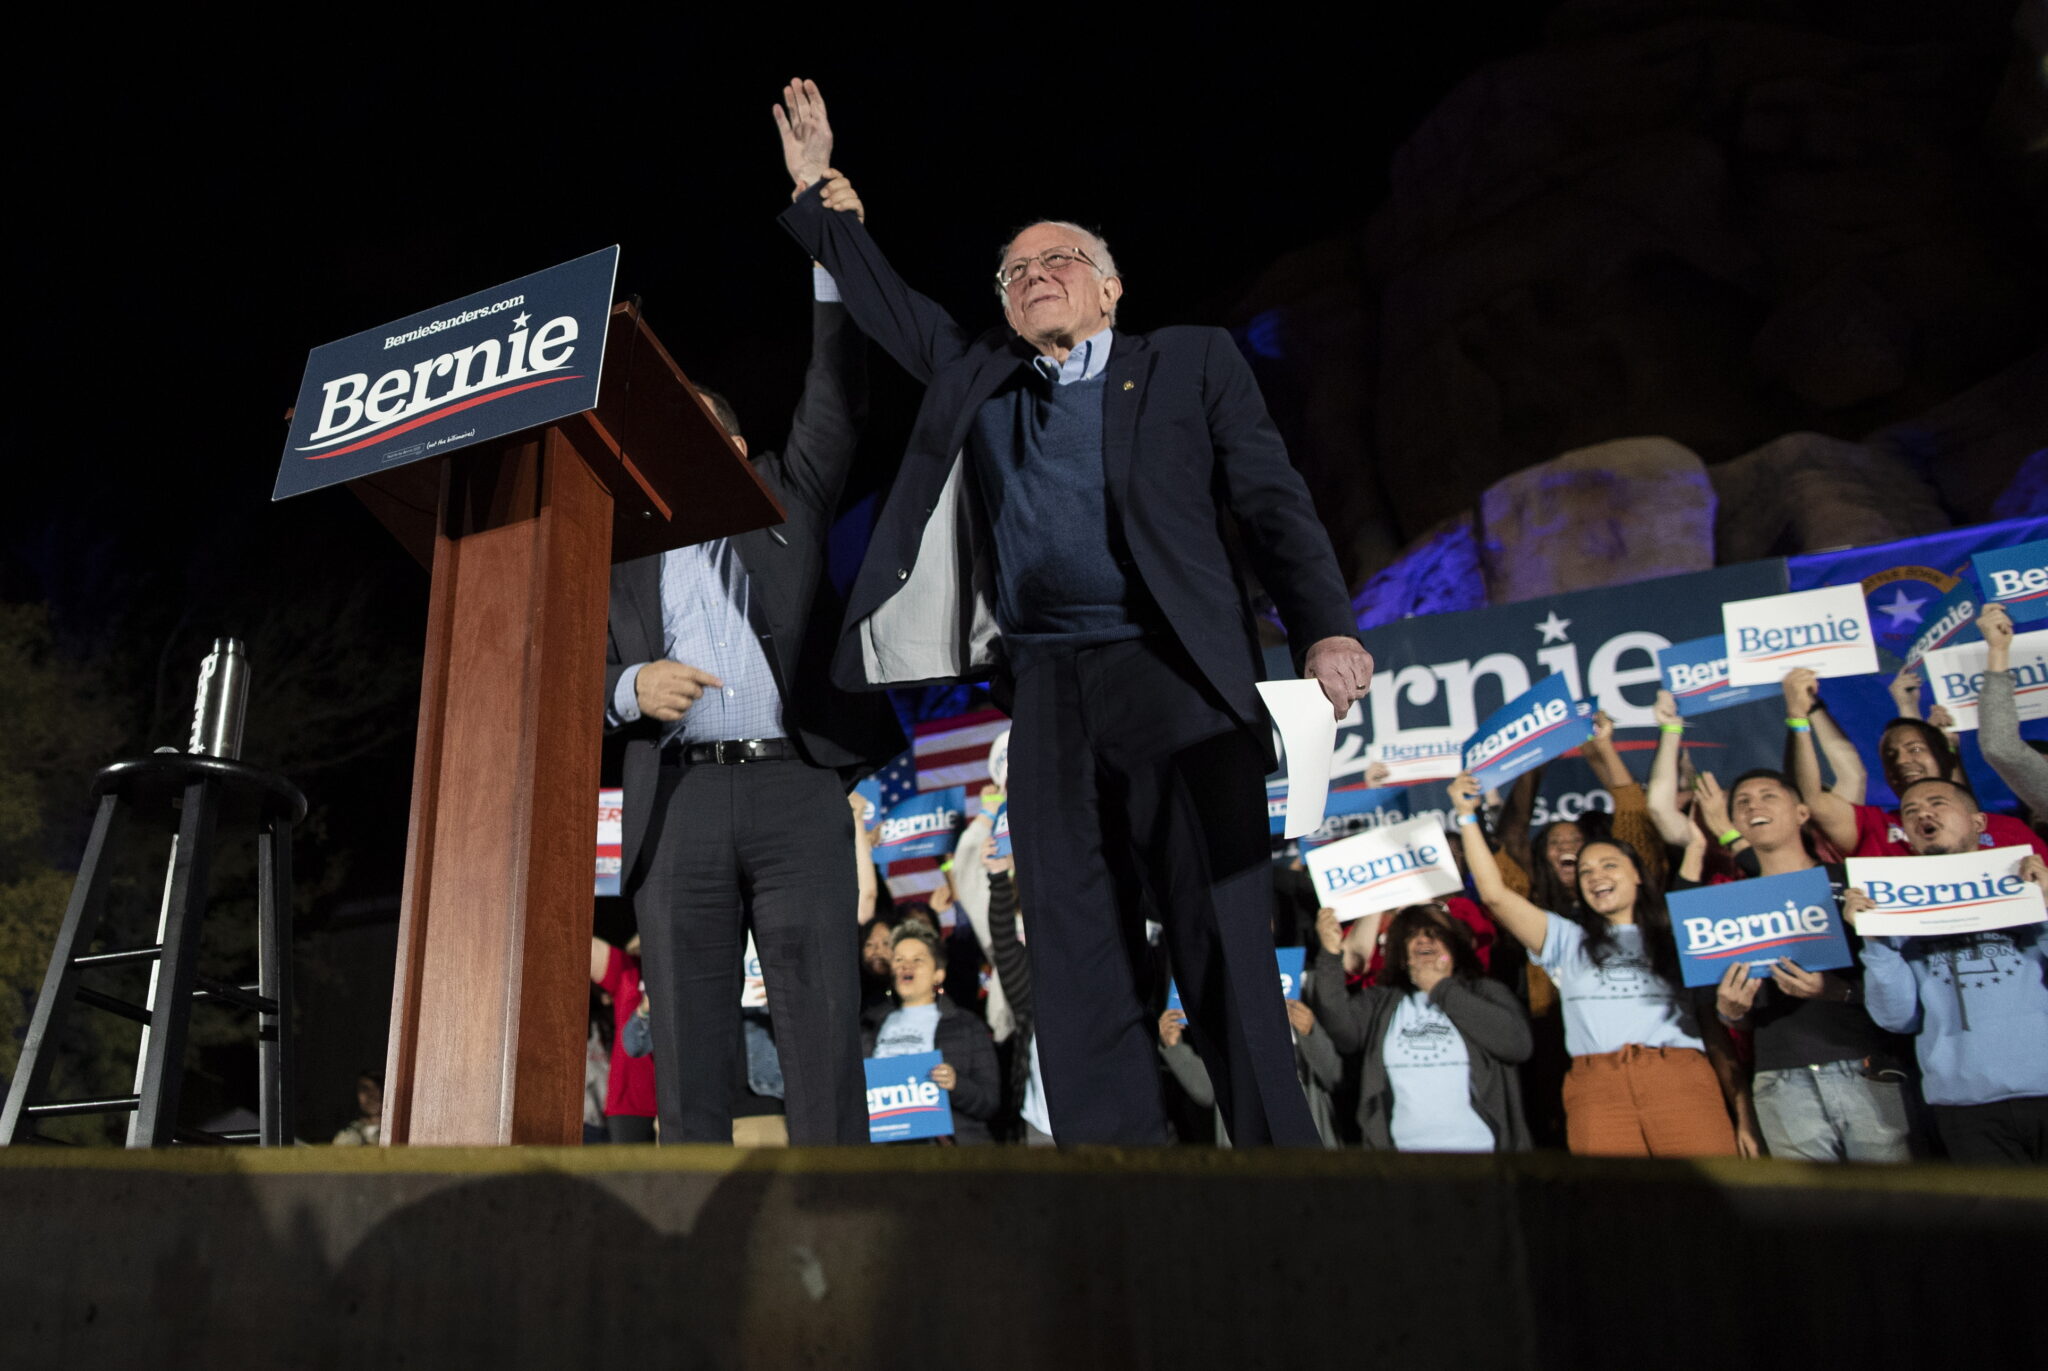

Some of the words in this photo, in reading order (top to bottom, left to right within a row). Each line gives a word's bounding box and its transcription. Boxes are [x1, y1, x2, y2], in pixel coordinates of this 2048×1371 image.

[382, 294, 525, 350] BernieSanders.com
[309, 310, 580, 442] Bernie
[1988, 565, 2048, 596] Be
[1737, 613, 1861, 652] Bernie
[1333, 611, 1673, 777] rnie
[1667, 657, 1729, 692] Ber
[1941, 656, 2048, 700] Beni
[1465, 698, 1568, 771] Bernie
[879, 806, 959, 842] Bernie
[1323, 842, 1440, 890] Bernie
[1863, 871, 2025, 906] Bernie
[1683, 899, 1829, 950] Bernie
[865, 1076, 941, 1112] ernie
